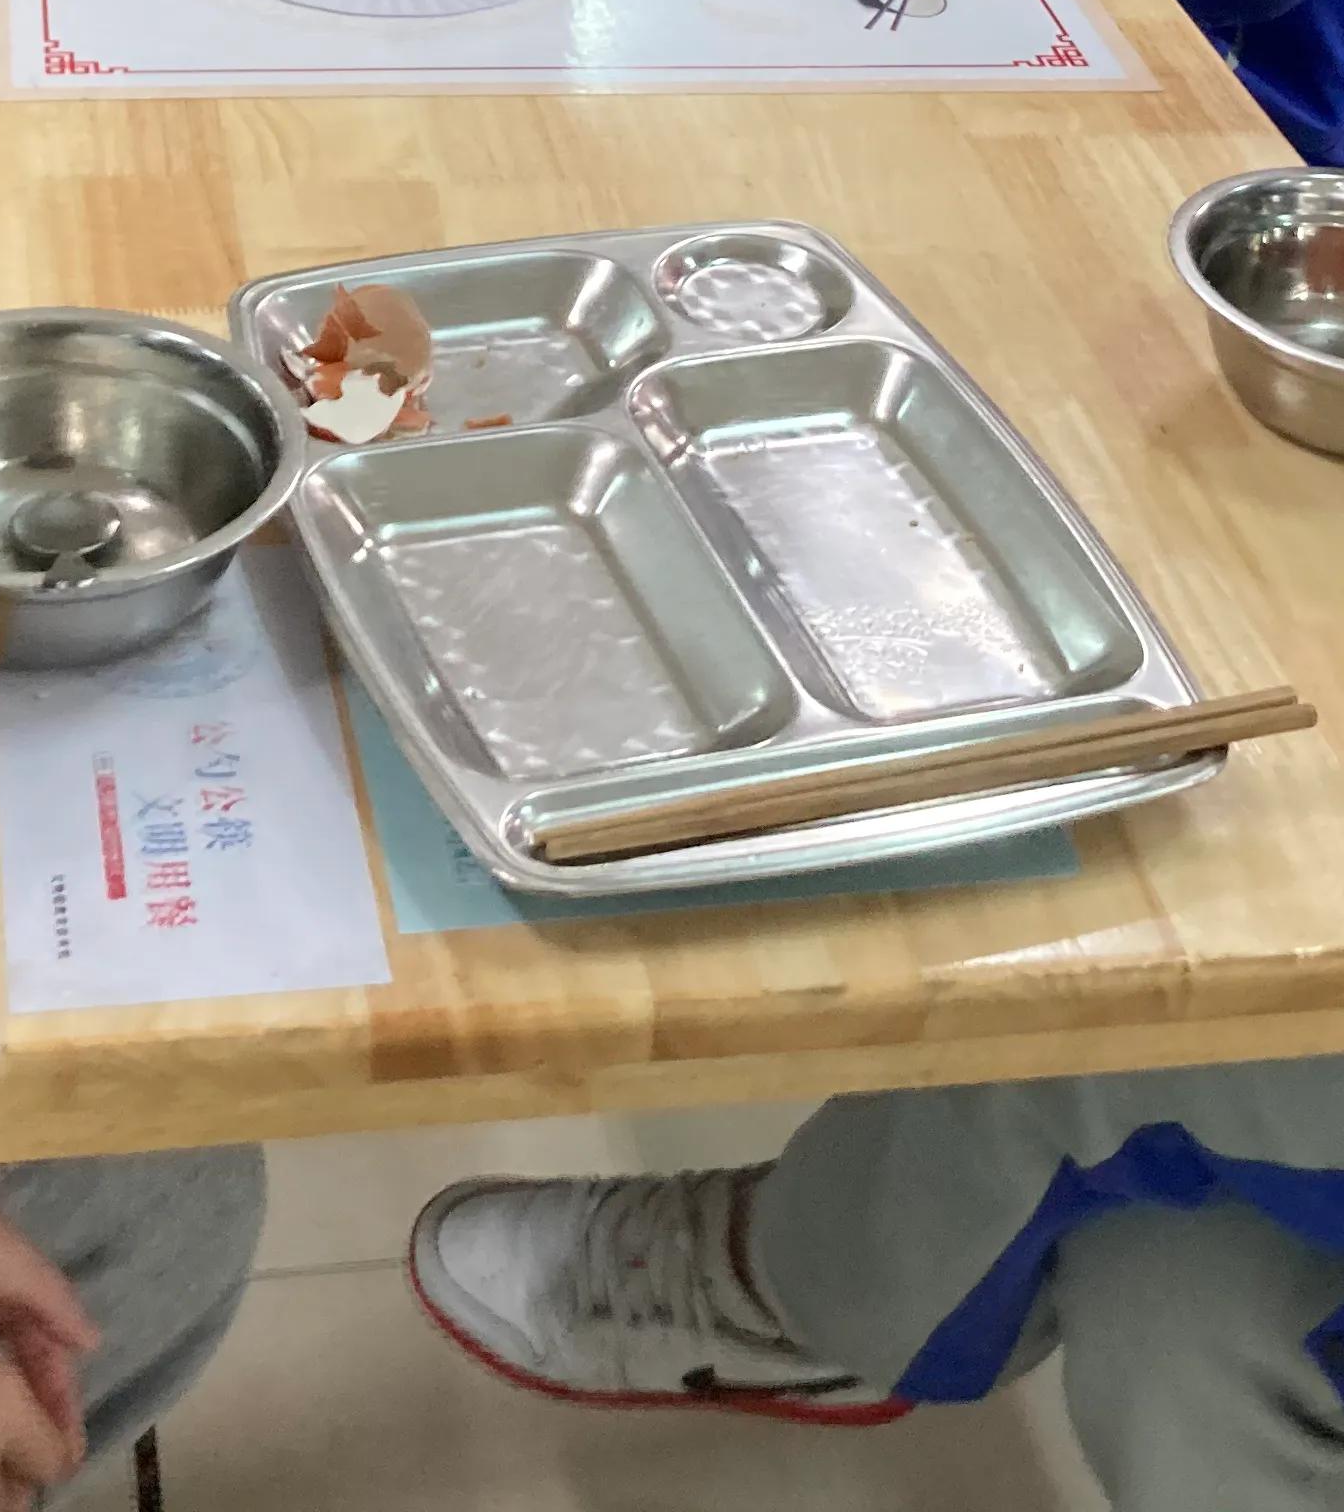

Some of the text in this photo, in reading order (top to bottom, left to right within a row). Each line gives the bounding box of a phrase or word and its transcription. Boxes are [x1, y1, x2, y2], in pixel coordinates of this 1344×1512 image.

[190, 721, 254, 851] 公勺公筷
[136, 795, 199, 928] 文明用餐
